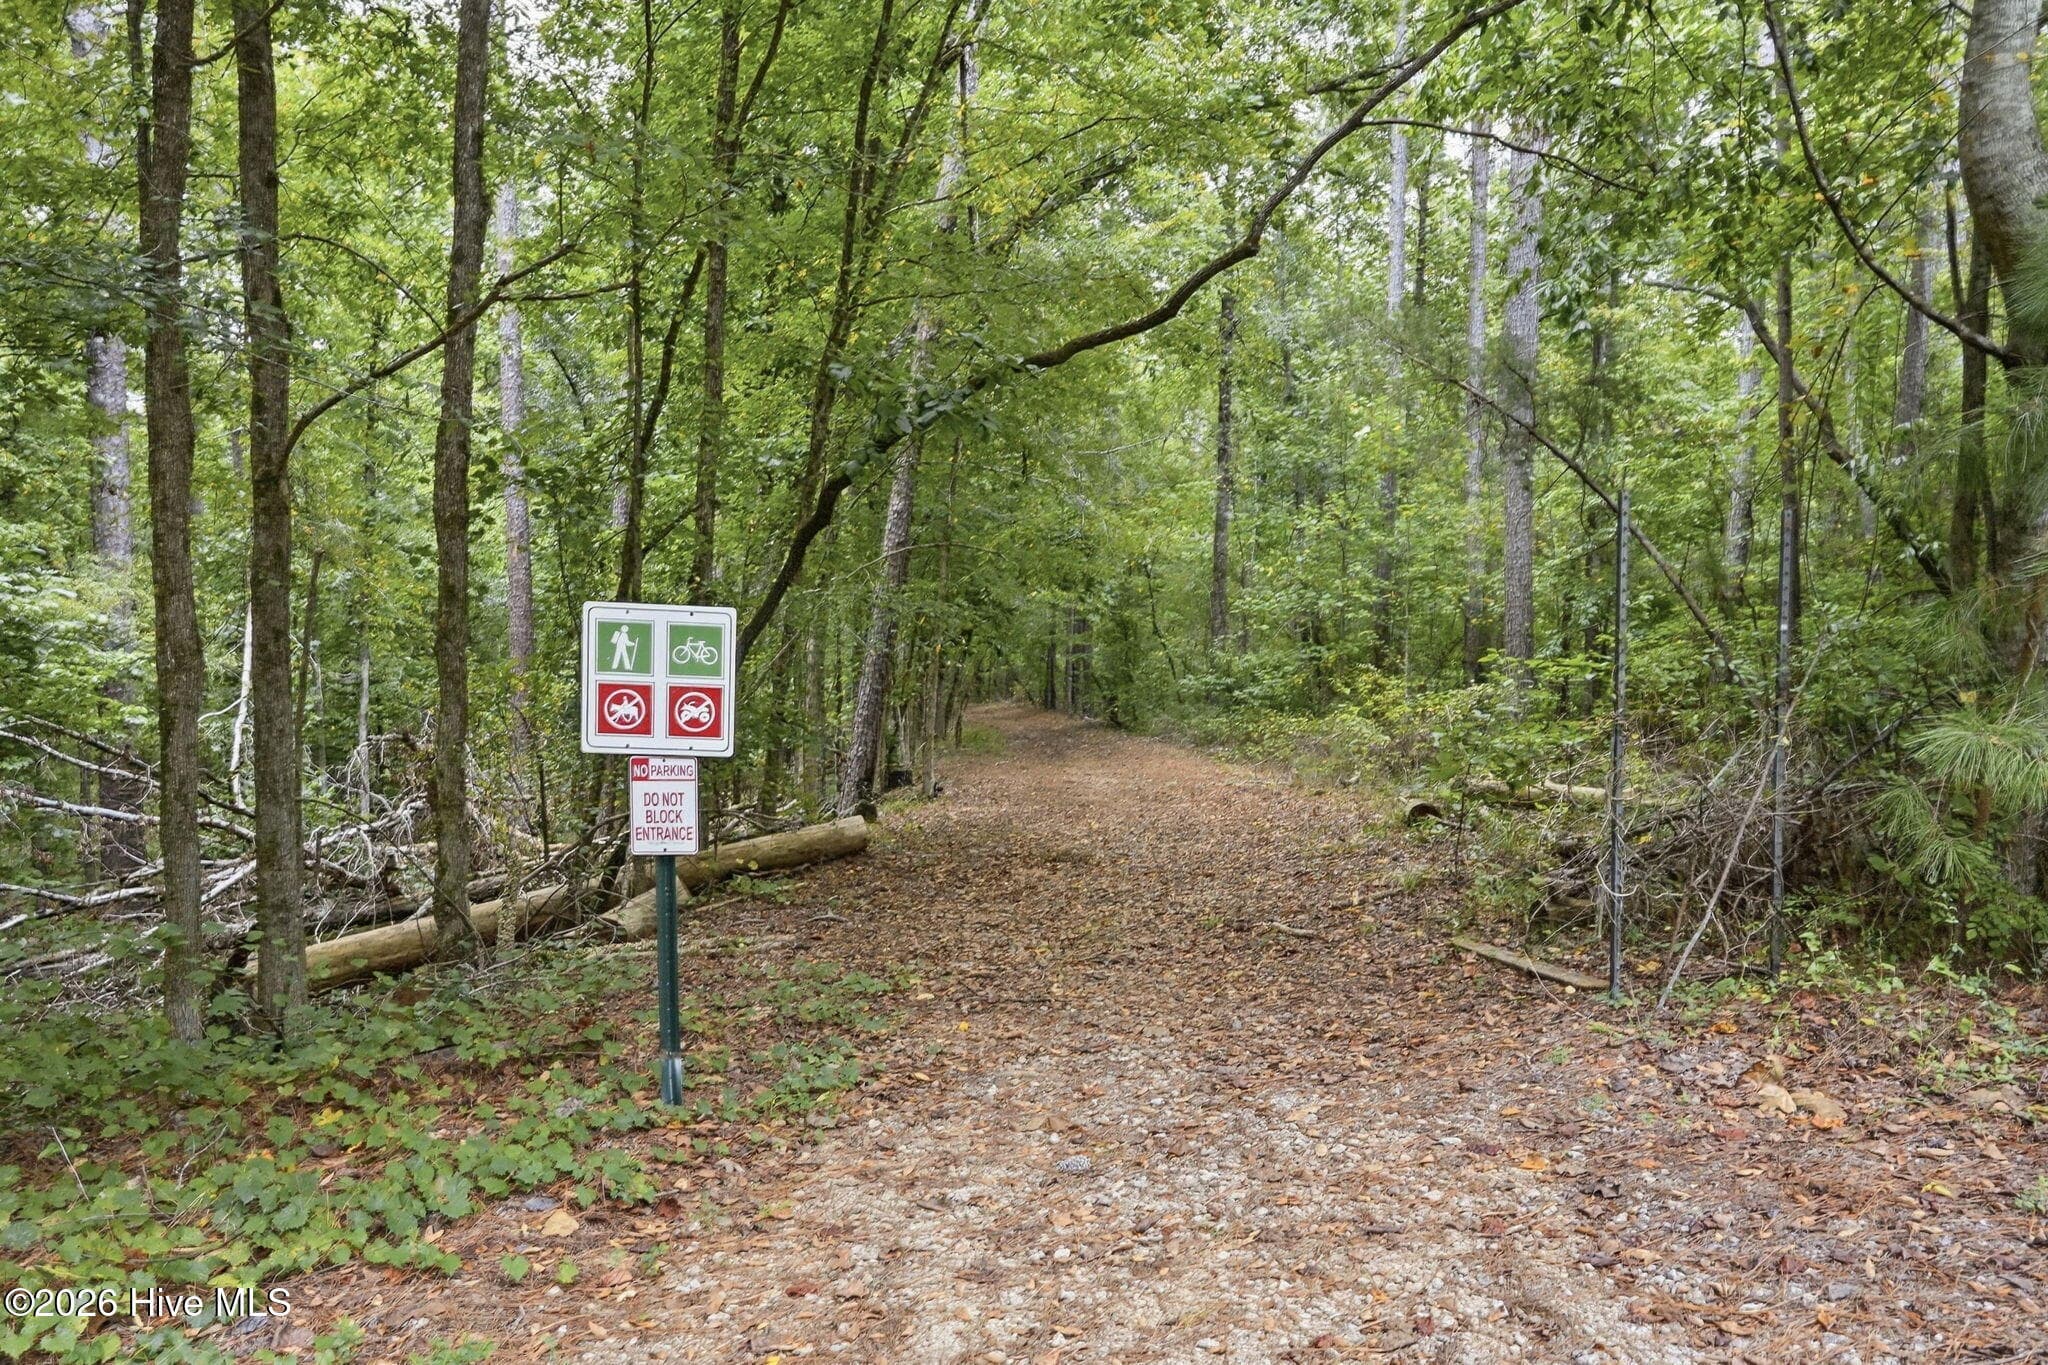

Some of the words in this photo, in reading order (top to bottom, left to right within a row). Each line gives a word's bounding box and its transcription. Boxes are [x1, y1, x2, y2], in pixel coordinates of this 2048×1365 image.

[633, 765, 648, 777] NO
[651, 765, 694, 777] PARKING
[644, 792, 659, 806] DO
[662, 792, 684, 806] NOT
[645, 810, 683, 823] BLOCK
[636, 826, 693, 840] ENTRANCE
